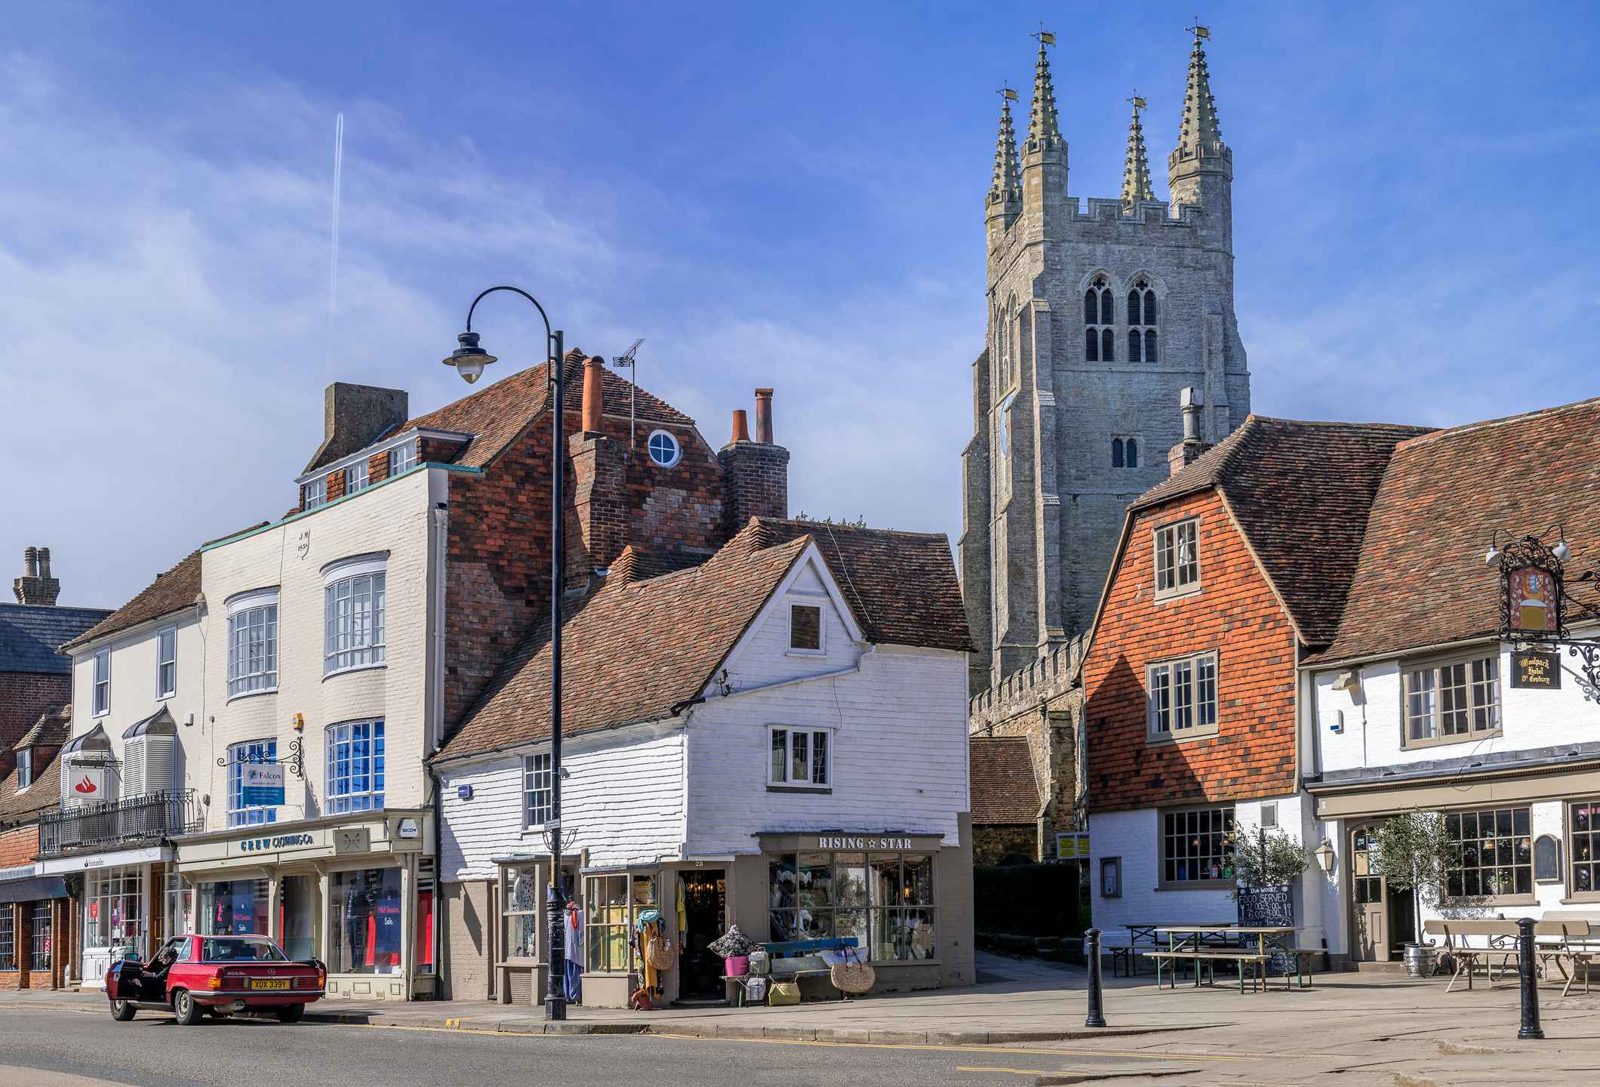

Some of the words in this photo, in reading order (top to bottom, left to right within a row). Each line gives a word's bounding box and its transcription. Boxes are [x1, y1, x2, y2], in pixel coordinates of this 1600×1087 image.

[259, 771, 282, 780] Falcon
[240, 838, 271, 851] CREW
[272, 834, 303, 848] CLOTHING
[819, 837, 864, 849] RISING
[880, 838, 912, 849] STAR
[1239, 895, 1257, 904] FOOD
[1260, 893, 1288, 903] SERVED
